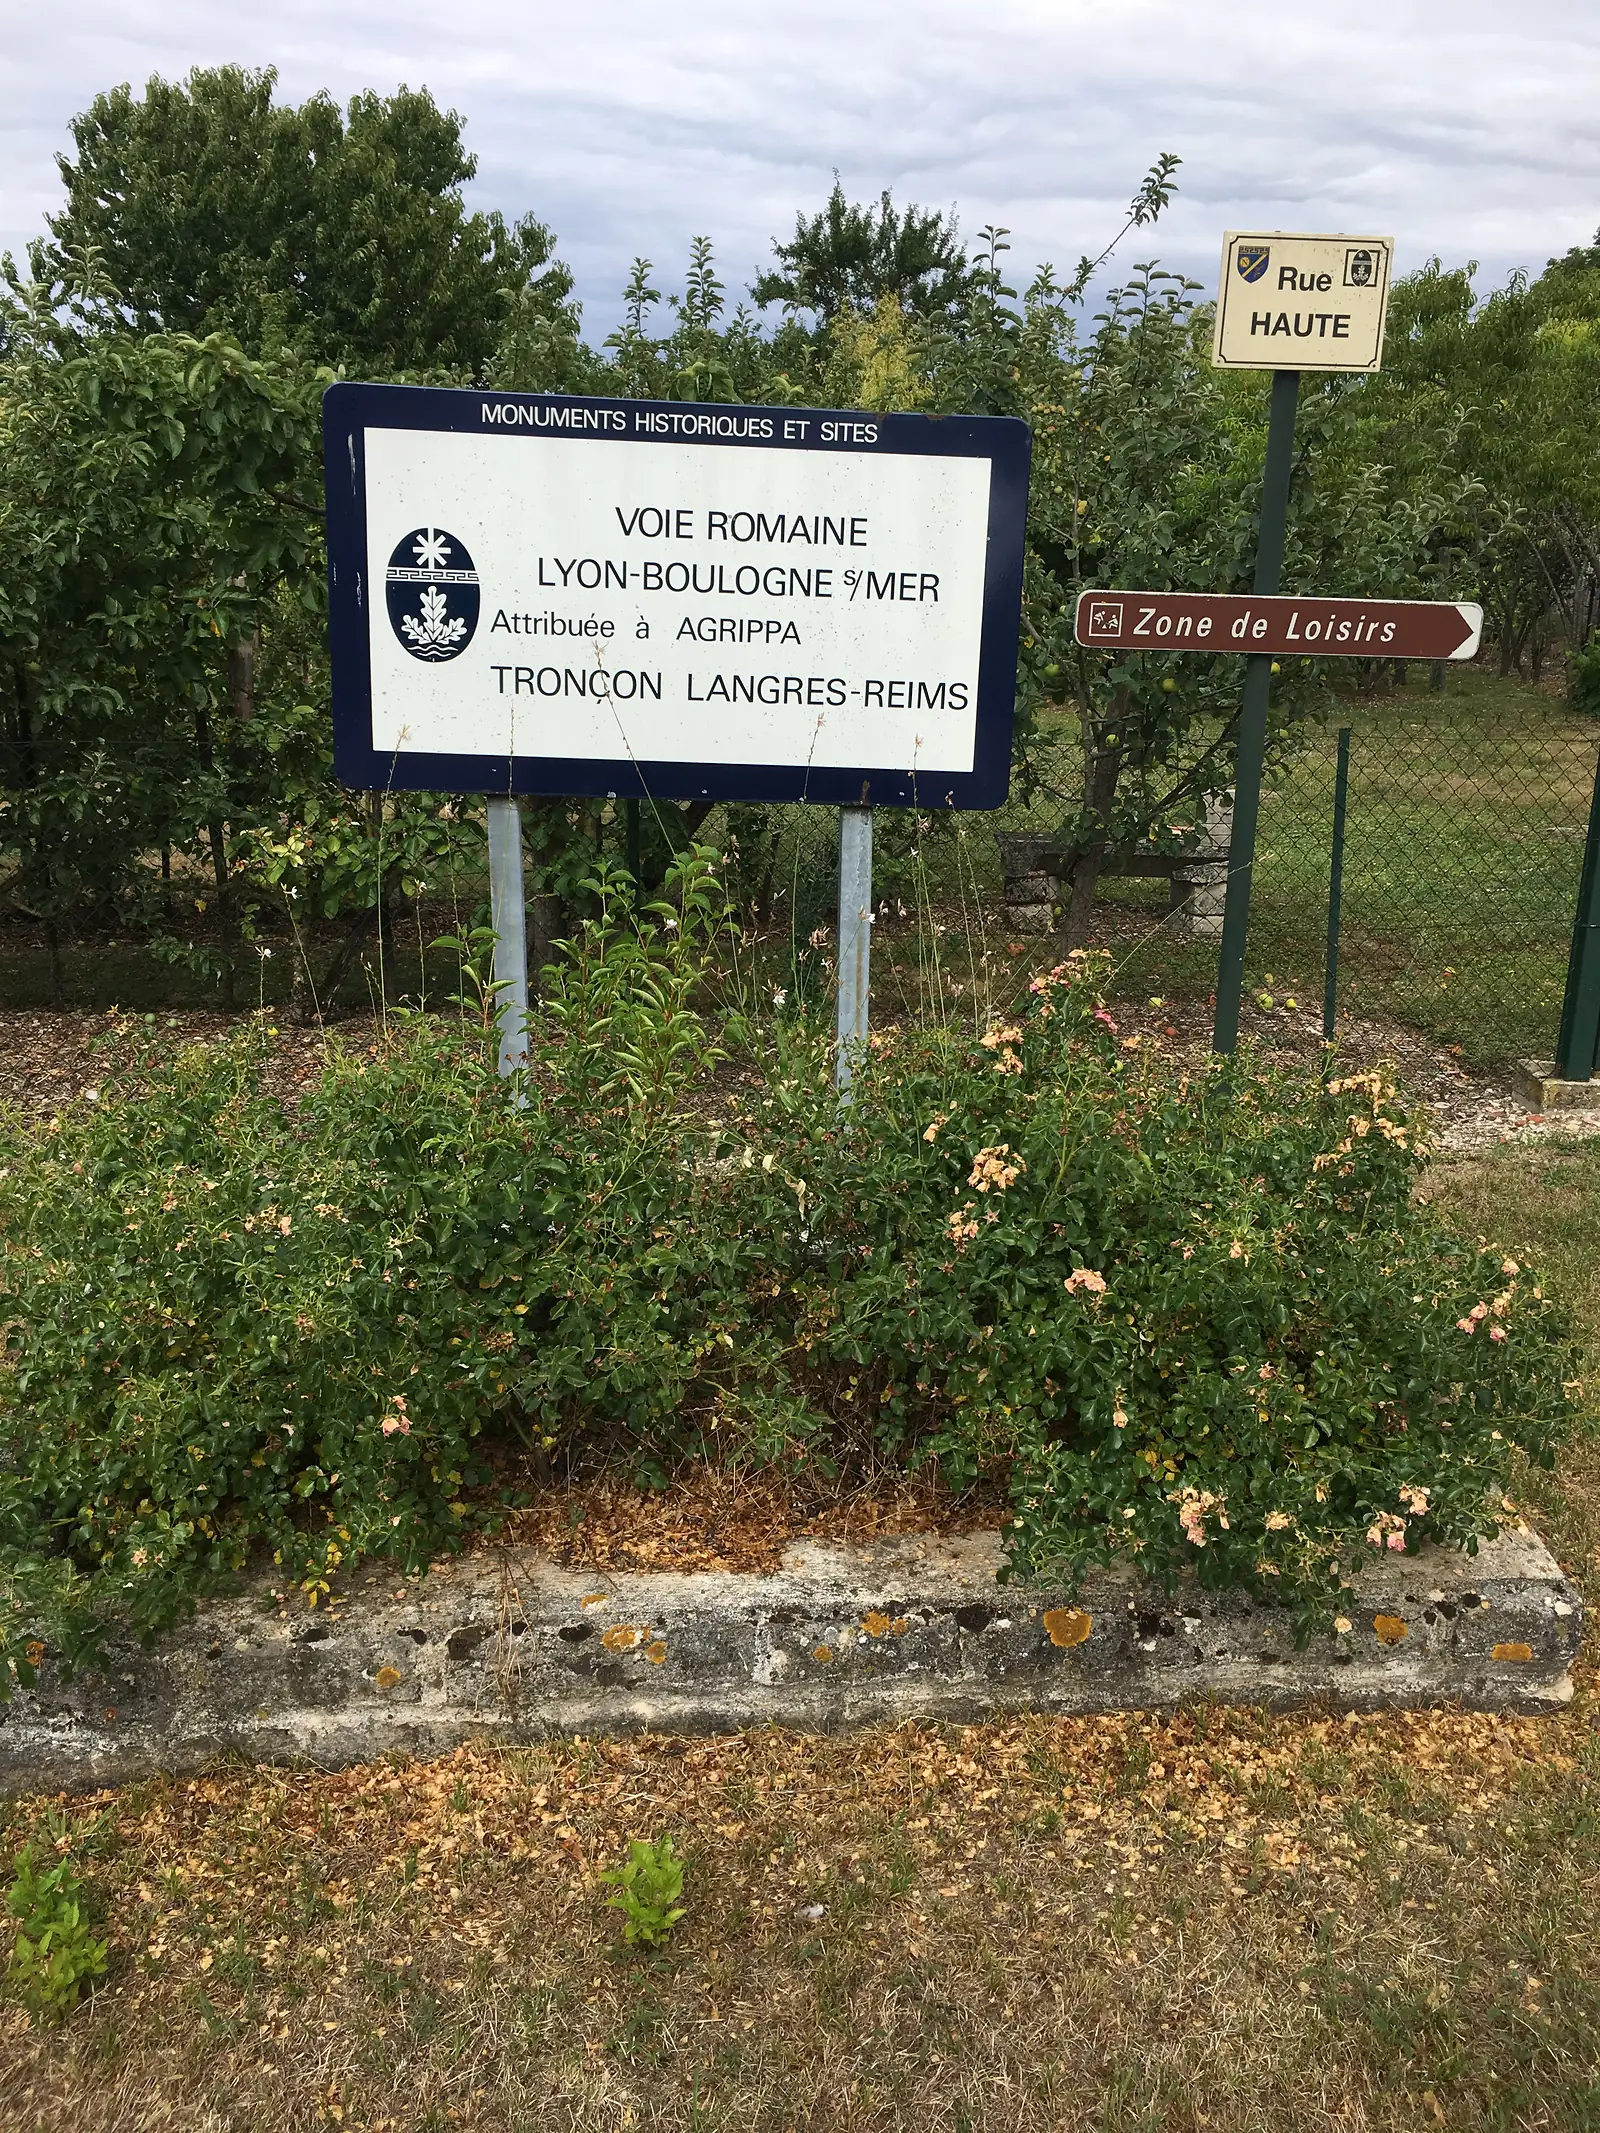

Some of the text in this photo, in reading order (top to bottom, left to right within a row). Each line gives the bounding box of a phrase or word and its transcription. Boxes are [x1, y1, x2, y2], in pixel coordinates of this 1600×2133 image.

[1278, 266, 1332, 292] Rue
[1250, 311, 1351, 338] HAUTE
[481, 403, 878, 444] MONUMENTS HISTORIQUES ET SITES
[615, 506, 868, 547] VOIE ROMAINE
[537, 557, 832, 598] LYON-BOULOGNE
[491, 609, 801, 645] Attribuée à AGRIPPA
[1133, 607, 1397, 642] Zone de Loisirs
[490, 665, 969, 711] TRONÇON LANGRES-REIMS
